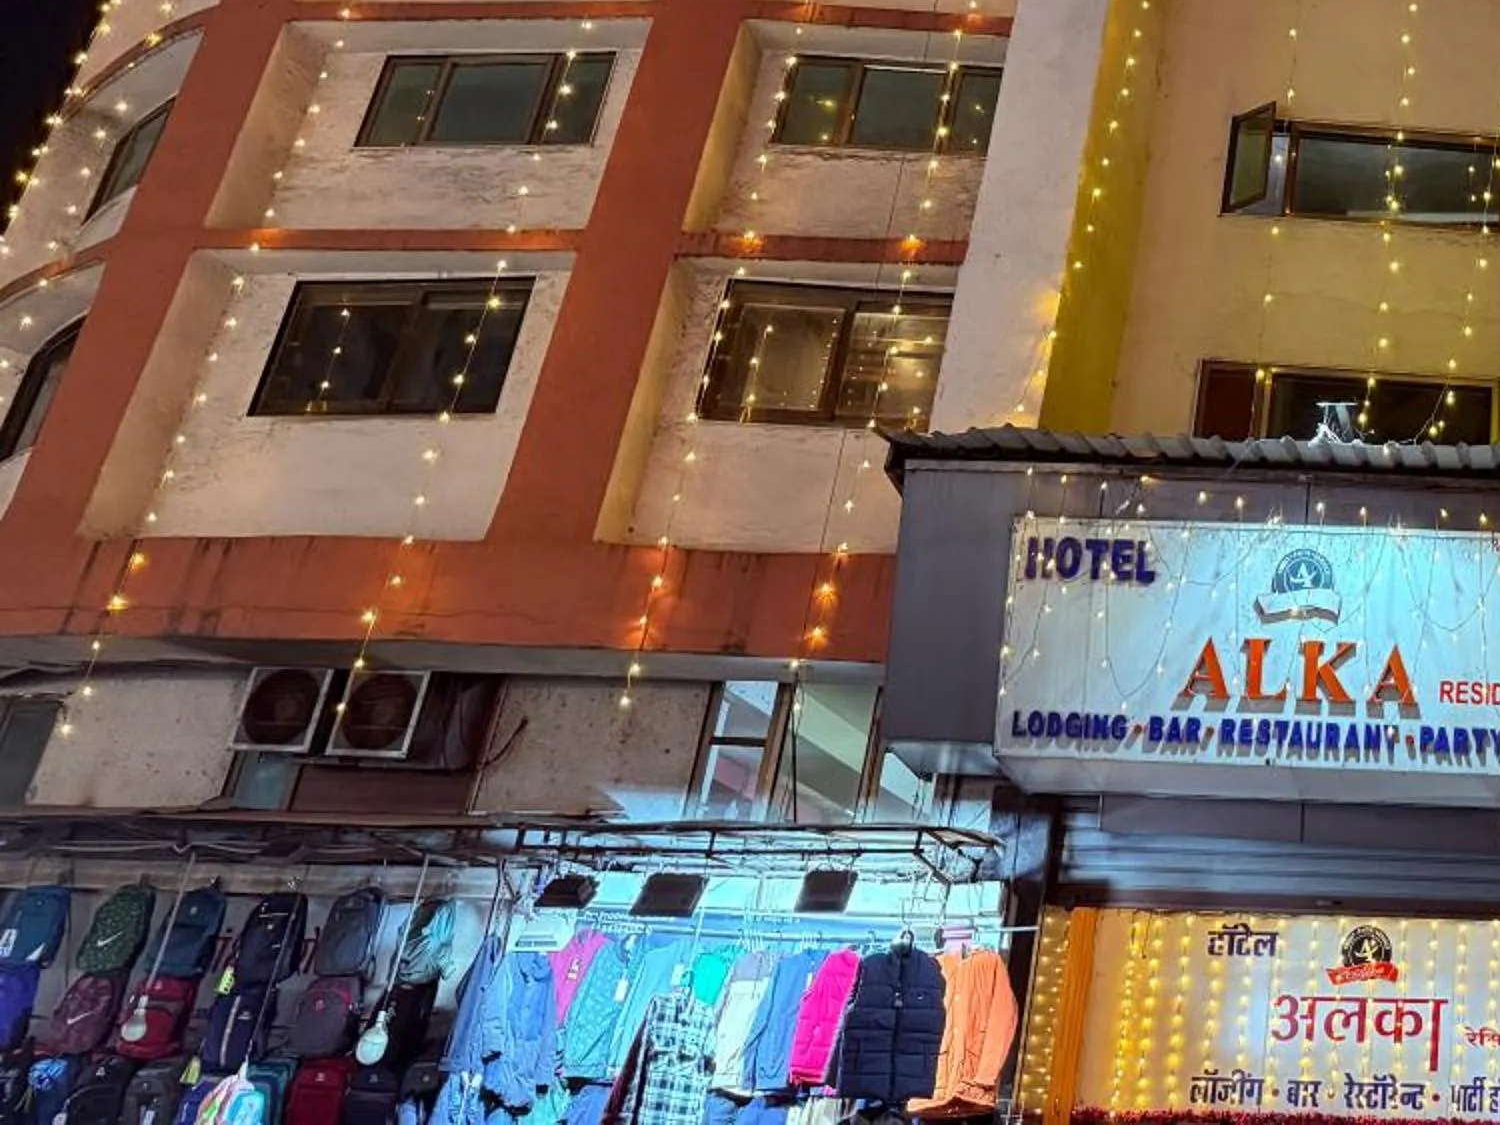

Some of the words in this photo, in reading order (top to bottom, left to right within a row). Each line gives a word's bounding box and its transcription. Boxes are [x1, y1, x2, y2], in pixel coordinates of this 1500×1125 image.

[1024, 536, 1156, 585] HOTEL
[1177, 635, 1420, 710] ALKA
[1011, 709, 1128, 741] LODGING
[1149, 715, 1202, 743] BAR
[1219, 718, 1399, 751] RESTAURANT
[1207, 922, 1279, 957] हॉटेल
[1271, 994, 1449, 1072] अलका
[1287, 1079, 1322, 1107] बार
